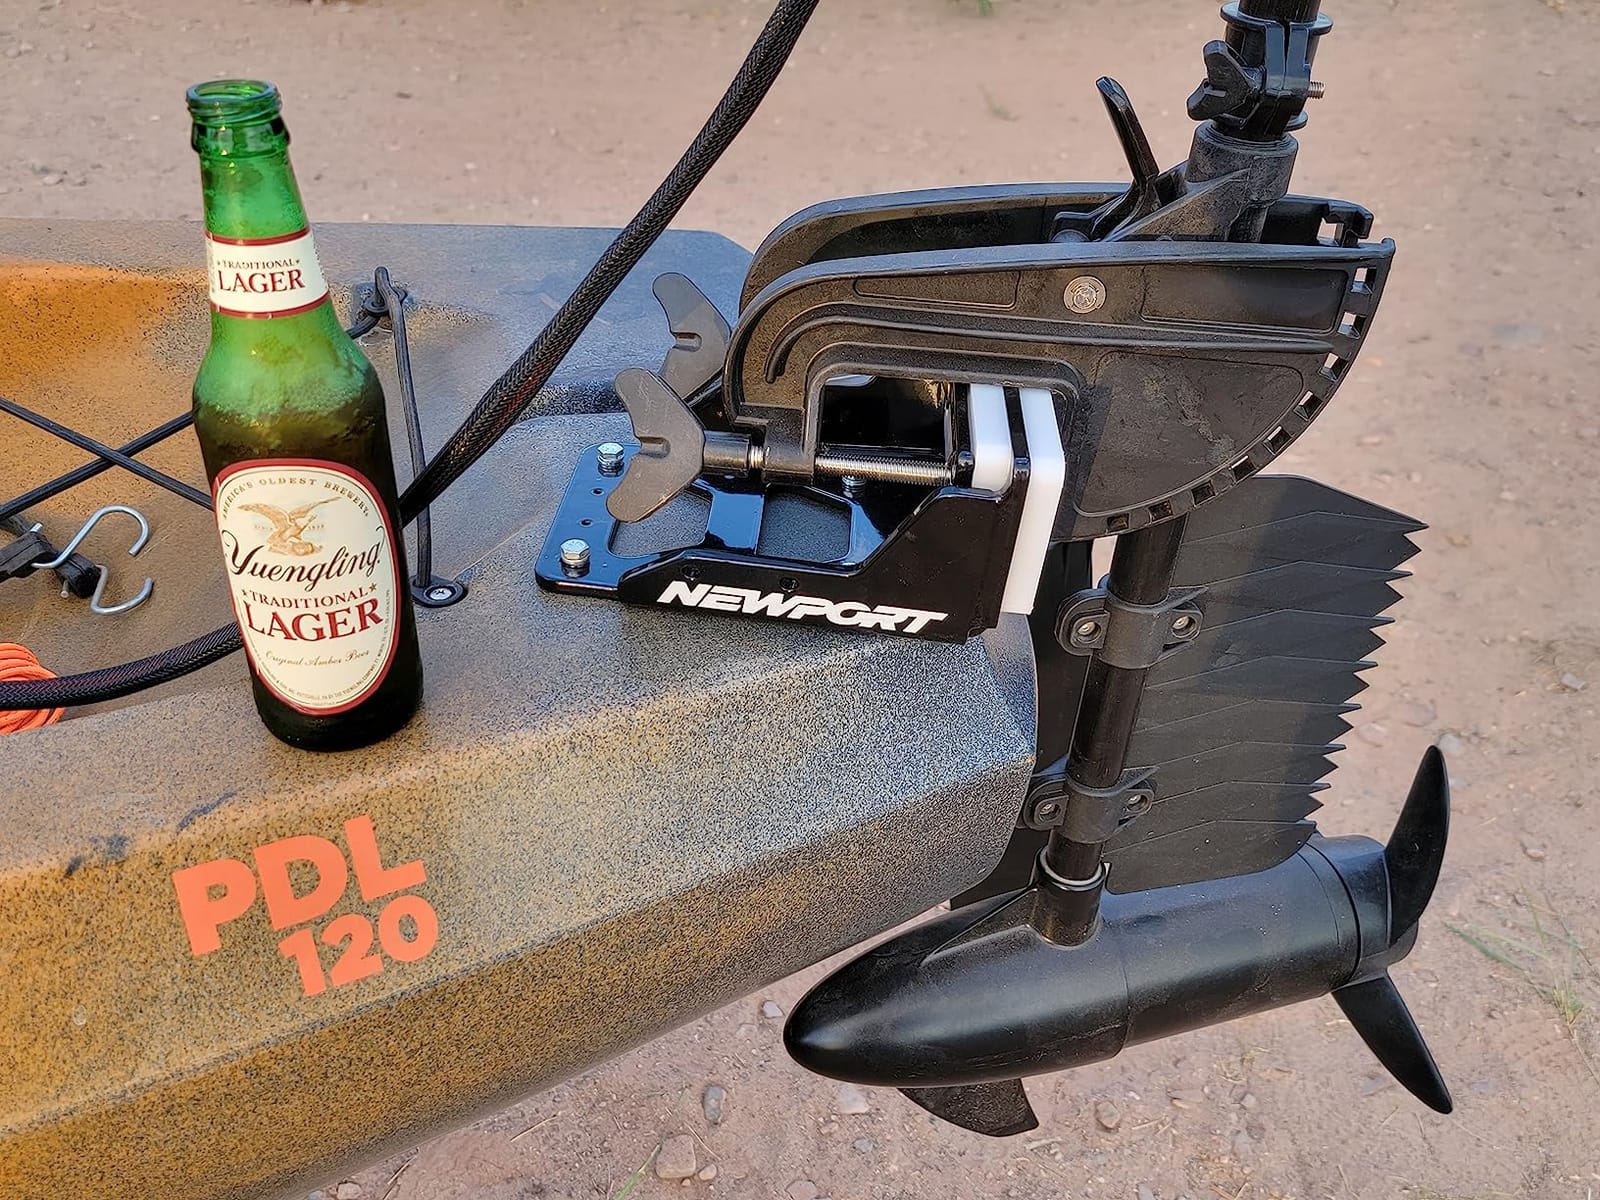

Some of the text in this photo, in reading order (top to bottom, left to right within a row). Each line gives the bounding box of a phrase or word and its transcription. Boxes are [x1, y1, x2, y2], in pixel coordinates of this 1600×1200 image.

[222, 258, 294, 270] TRADITIONAL
[218, 268, 306, 293] LAGER
[259, 477, 318, 486] OLDEST
[250, 586, 369, 609] TRADITIONAL
[656, 580, 949, 634] NEWPORT
[243, 597, 384, 642] LAGER
[265, 650, 304, 666] Original
[172, 814, 428, 957] PDL
[277, 894, 439, 997] 120
